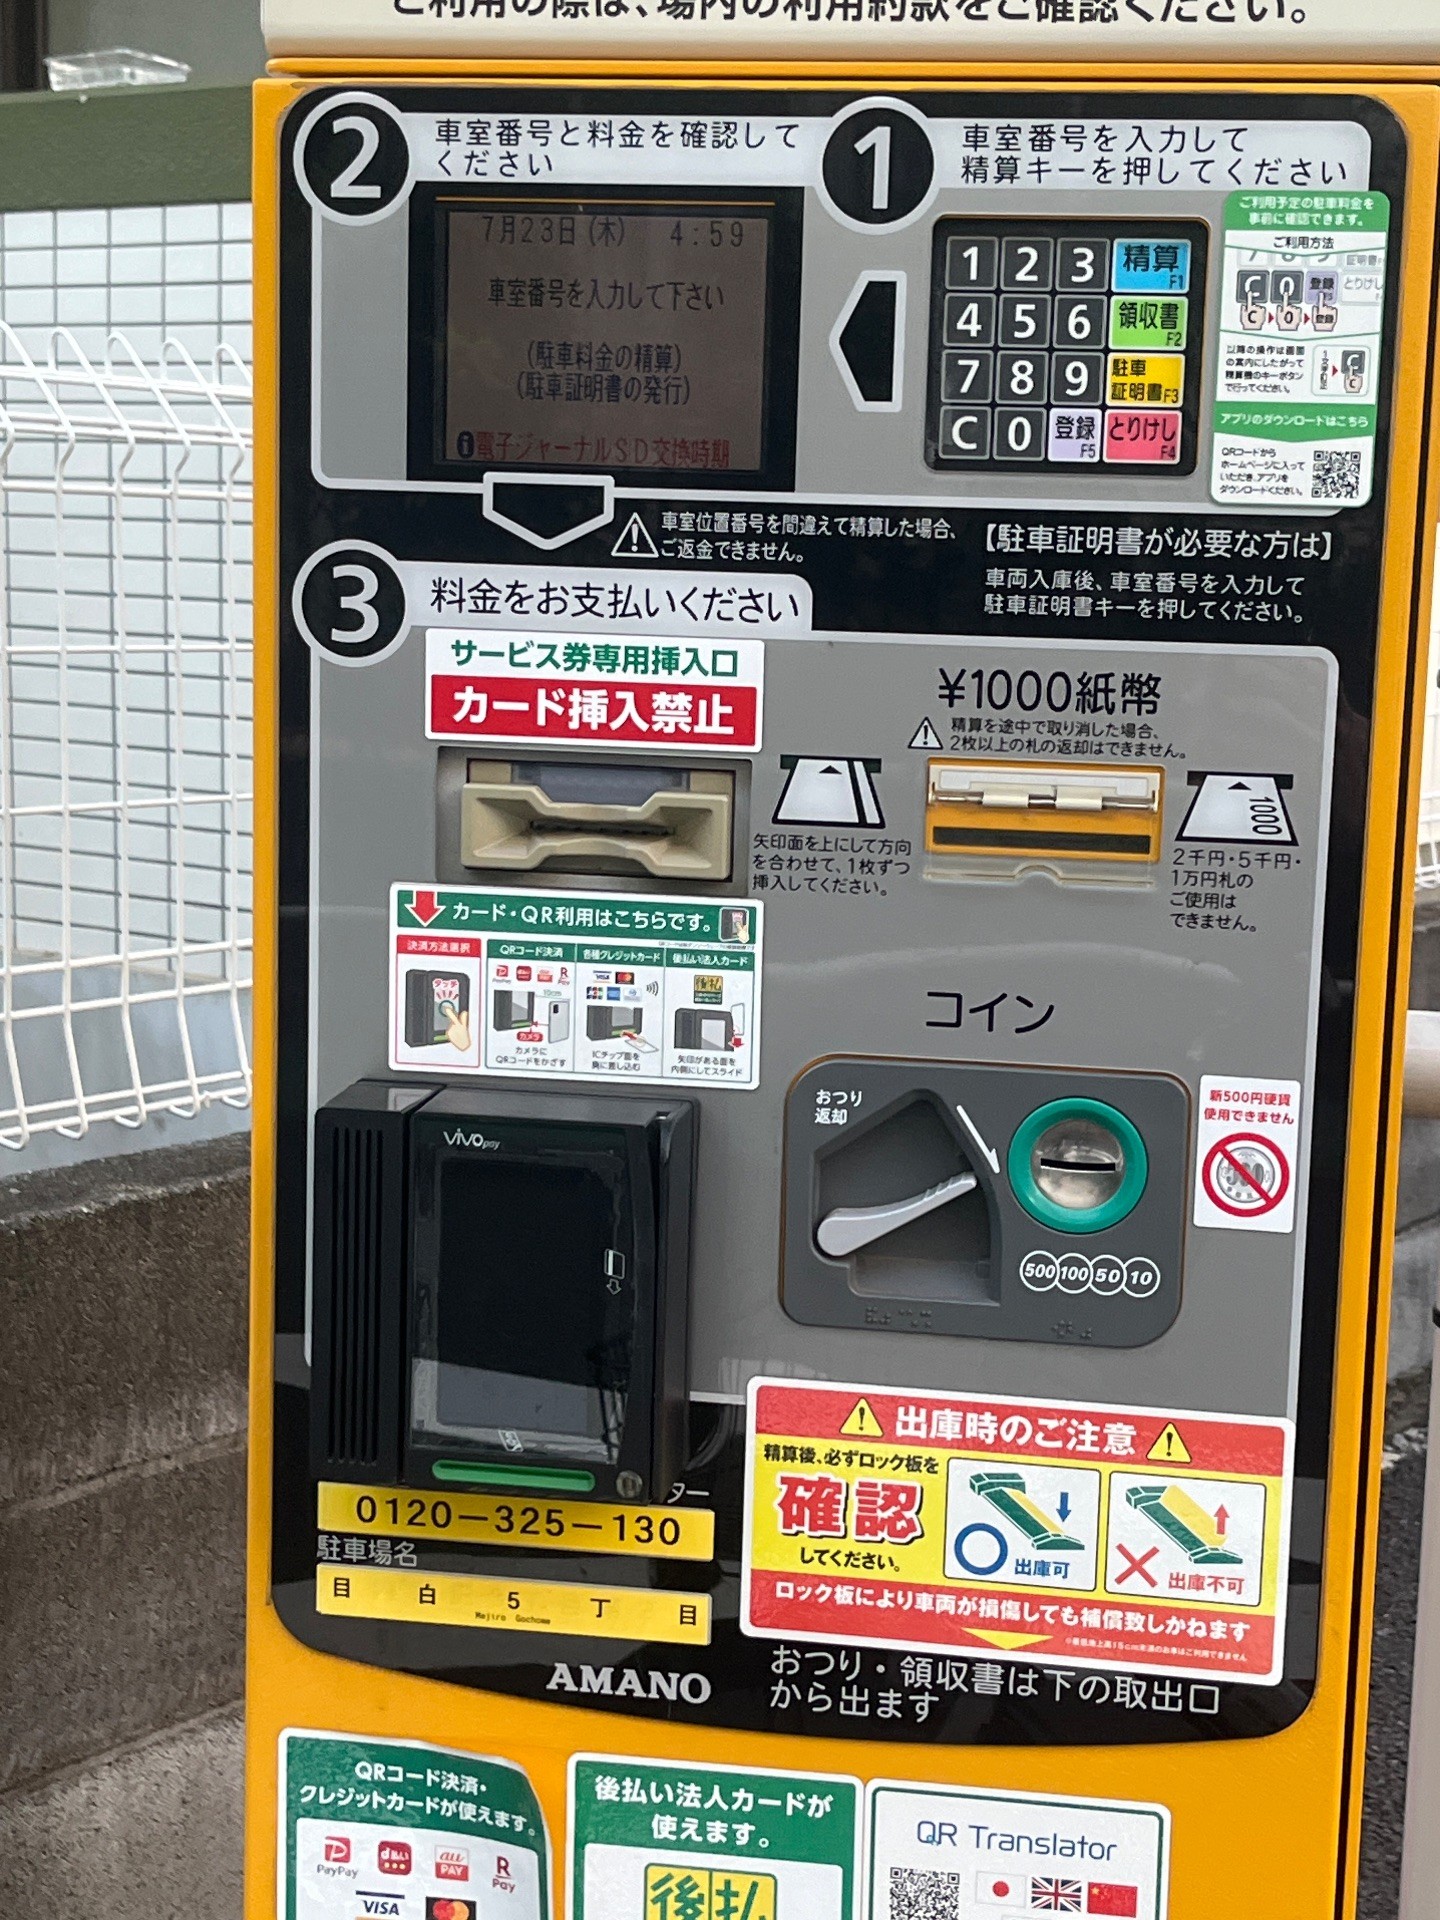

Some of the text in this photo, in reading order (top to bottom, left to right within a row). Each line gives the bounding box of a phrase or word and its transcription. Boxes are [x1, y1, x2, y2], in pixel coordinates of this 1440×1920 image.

[436, 118, 799, 150] 車室番号と料金を確認して
[962, 124, 1249, 154] 車室番号を入力して
[331, 117, 381, 199] 2
[436, 150, 553, 177] ください
[854, 126, 891, 210] 1
[961, 155, 1348, 186] 精算キーを押してください
[670, 220, 744, 248] 4:59
[1273, 236, 1335, 250] ご利用方法
[963, 246, 978, 281] 1
[1015, 246, 1039, 282] 2
[1071, 247, 1095, 283] 3
[1123, 244, 1179, 272] 精算
[488, 277, 724, 311] 車室番号を入力して下さい
[1169, 275, 1183, 289] F1
[956, 303, 982, 337] 4
[1013, 304, 1036, 338] 5
[1068, 304, 1091, 340] 6
[1118, 303, 1179, 330] 領収書
[1166, 332, 1182, 347] F2
[957, 360, 980, 394] 7
[1010, 360, 1034, 395] 8
[1064, 361, 1089, 396] 9
[1112, 359, 1146, 377] 駐車
[1111, 383, 1162, 401] 証明書
[1164, 388, 1179, 403] F3
[951, 415, 978, 450] C
[1008, 416, 1032, 451] 0
[1055, 416, 1095, 440] 登録
[1109, 417, 1176, 442] とりけし
[1220, 413, 1369, 428] アプリのダウンロードはこちら
[1080, 444, 1096, 459] F5
[1161, 446, 1176, 461] F4
[661, 511, 957, 540] 車室位置番号を間違えて精算した場合、
[661, 539, 805, 563] ご返金できません。
[984, 523, 1333, 561] 【駐車証明書が必要な方は】
[985, 568, 1306, 597] 車両入庫後、車室番号を入力して
[330, 564, 380, 644] 3
[430, 577, 800, 624] 料金をお支払いください
[984, 593, 1304, 624] 駐車証明書キーを押してください。
[450, 639, 739, 678] サービス券専用挿入口
[452, 685, 736, 736] カード挿入禁止
[950, 716, 1162, 740] 精算を途中で取り消した場合、
[949, 735, 1187, 760] 2枚以上の札の返却はできません。
[753, 833, 912, 858] 矢印面を上にして方向
[752, 854, 912, 877] を合わせて、1枚ずつ
[1171, 870, 1254, 889] 1万円札の
[752, 875, 888, 897] 挿入してください。
[1170, 891, 1237, 910] ご使用は
[452, 901, 712, 933] カード・QR利用はこちらです。
[1170, 912, 1257, 933] できません。
[926, 990, 1055, 1034] コイン
[815, 1089, 864, 1108] おつり
[1209, 1089, 1291, 1107] 新500円硬貨
[814, 1107, 848, 1126] 返却
[1203, 1107, 1295, 1126] 使用できません
[1024, 1263, 1153, 1286] 500 100 50 10
[894, 1405, 1138, 1457] 出庫時のご注意
[763, 1443, 940, 1475] 精算後、必ずロック板を
[774, 1471, 926, 1546] 確認
[316, 1535, 418, 1567] 駐車場名
[798, 1547, 906, 1574] してください。
[1013, 1557, 1071, 1581] 出庫可
[1167, 1571, 1246, 1597] 出庫不可
[775, 1581, 1251, 1643] ロック板により車両が損傷しても補償致しかねます
[546, 1662, 712, 1705] AMANO
[770, 1644, 1222, 1715] おつり・領収書は下の取出口
[770, 1684, 940, 1723] から出ます
[299, 1784, 537, 1837] クレジットカードが使えます。
[594, 1774, 835, 1819] 後払い法人カードが
[651, 1812, 770, 1849] 使えます。
[916, 1820, 1118, 1862] QR Translator
[316, 1863, 359, 1880] PayPay
[439, 1865, 464, 1877] PAY
[491, 1877, 517, 1895] Pay
[363, 1900, 400, 1916] VISA
